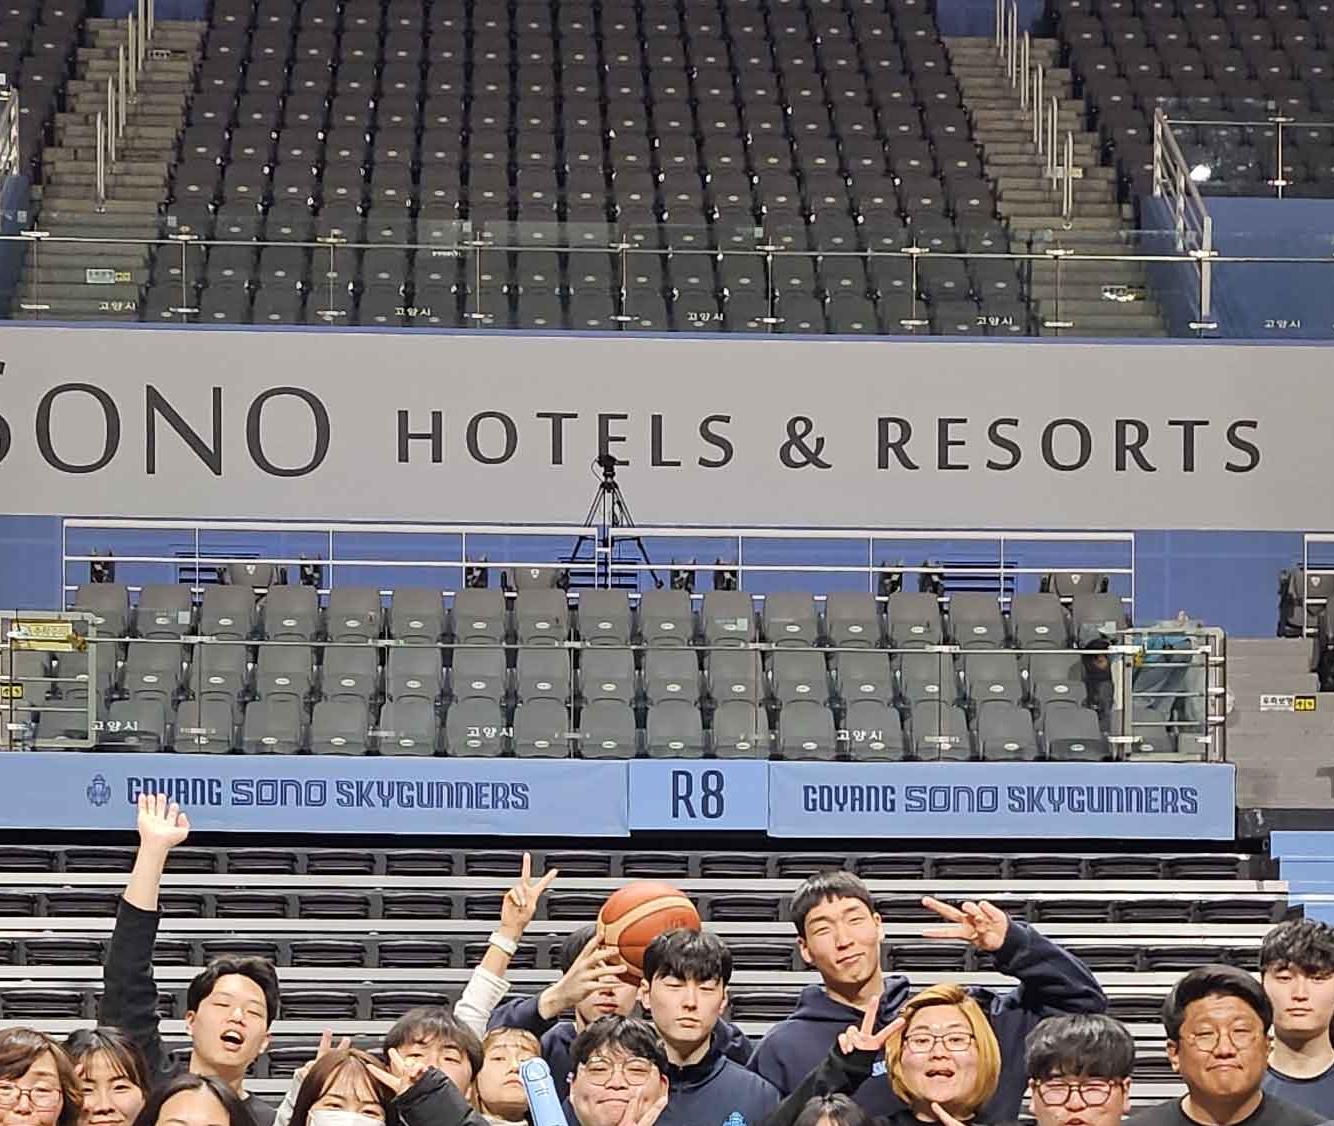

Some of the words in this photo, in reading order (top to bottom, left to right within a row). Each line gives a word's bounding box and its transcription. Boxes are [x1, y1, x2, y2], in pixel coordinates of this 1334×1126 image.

[398, 410, 734, 468] HOTELS
[780, 416, 832, 469] &
[878, 417, 1261, 473] RESORTS
[91, 720, 138, 732] 고양시
[466, 726, 514, 738] 고양시
[836, 729, 883, 742] 고양시
[336, 781, 529, 810] SKYGUNNERS
[671, 770, 725, 819] R8
[803, 785, 896, 812] GOYANG
[1007, 786, 1198, 814] SKYGUNNERS
